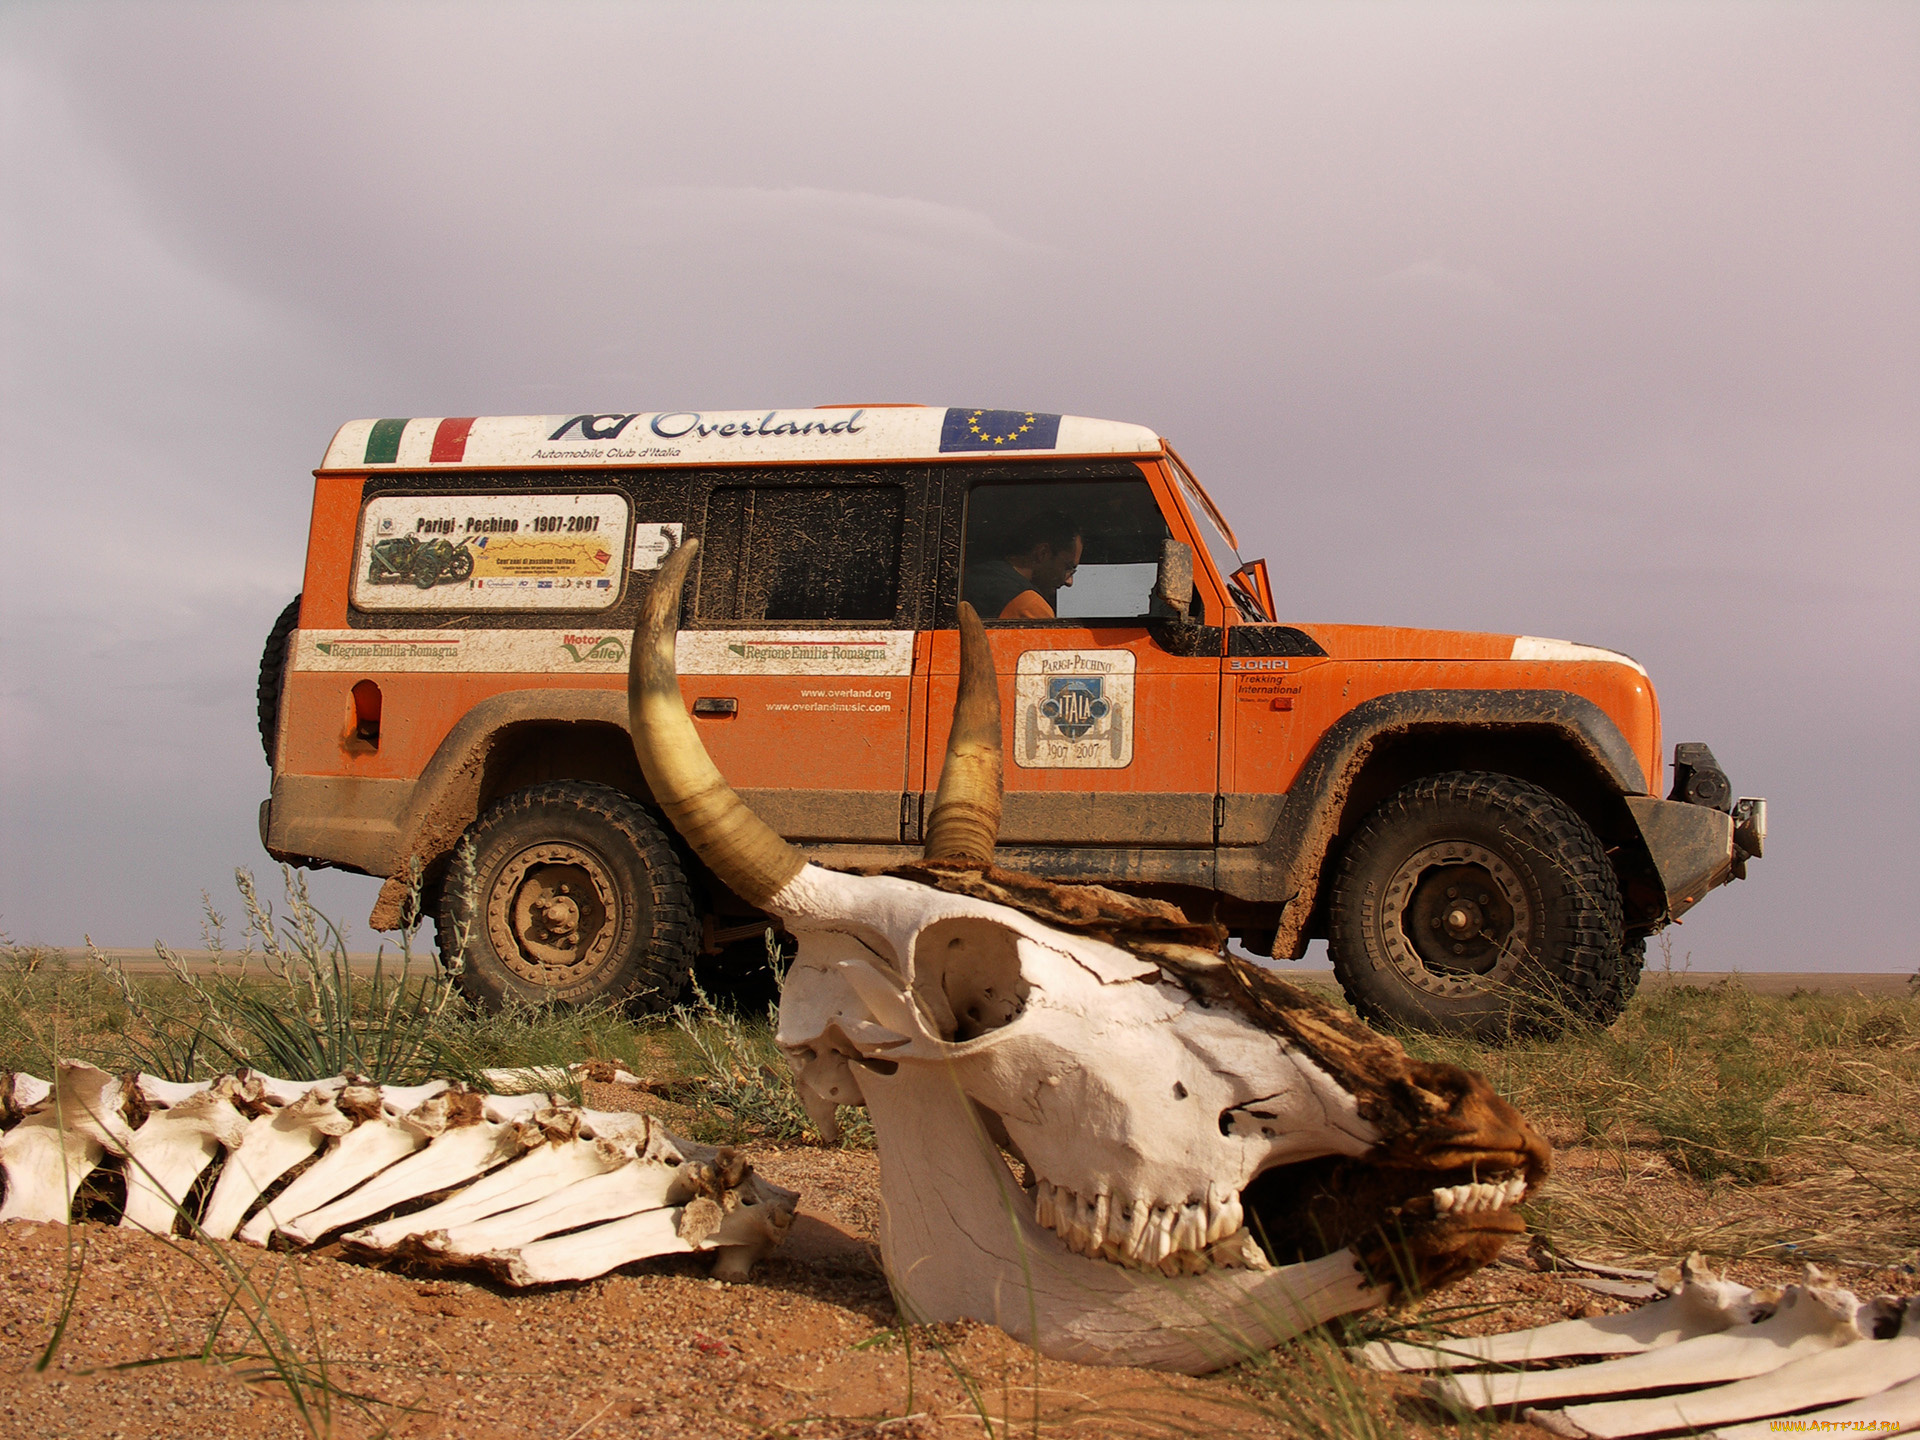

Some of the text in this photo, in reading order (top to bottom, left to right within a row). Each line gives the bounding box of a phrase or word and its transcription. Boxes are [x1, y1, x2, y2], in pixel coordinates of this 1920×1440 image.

[651, 409, 866, 440] Overland
[532, 447, 681, 460] Automobile Club d'Italia
[416, 517, 456, 534] Parigi
[466, 516, 519, 533] Pechino
[533, 515, 600, 532] 1907-2007
[563, 634, 602, 645] Motor
[560, 637, 626, 663] Valley
[1240, 674, 1283, 685] Trekking
[801, 688, 892, 700] www.overland.org
[1238, 686, 1302, 694] International
[765, 702, 891, 712] www.overlandmusic.com
[1059, 692, 1091, 724] ITALA
[1047, 742, 1100, 759] 1907 2007
[1361, 897, 1386, 972] PIRELLI
